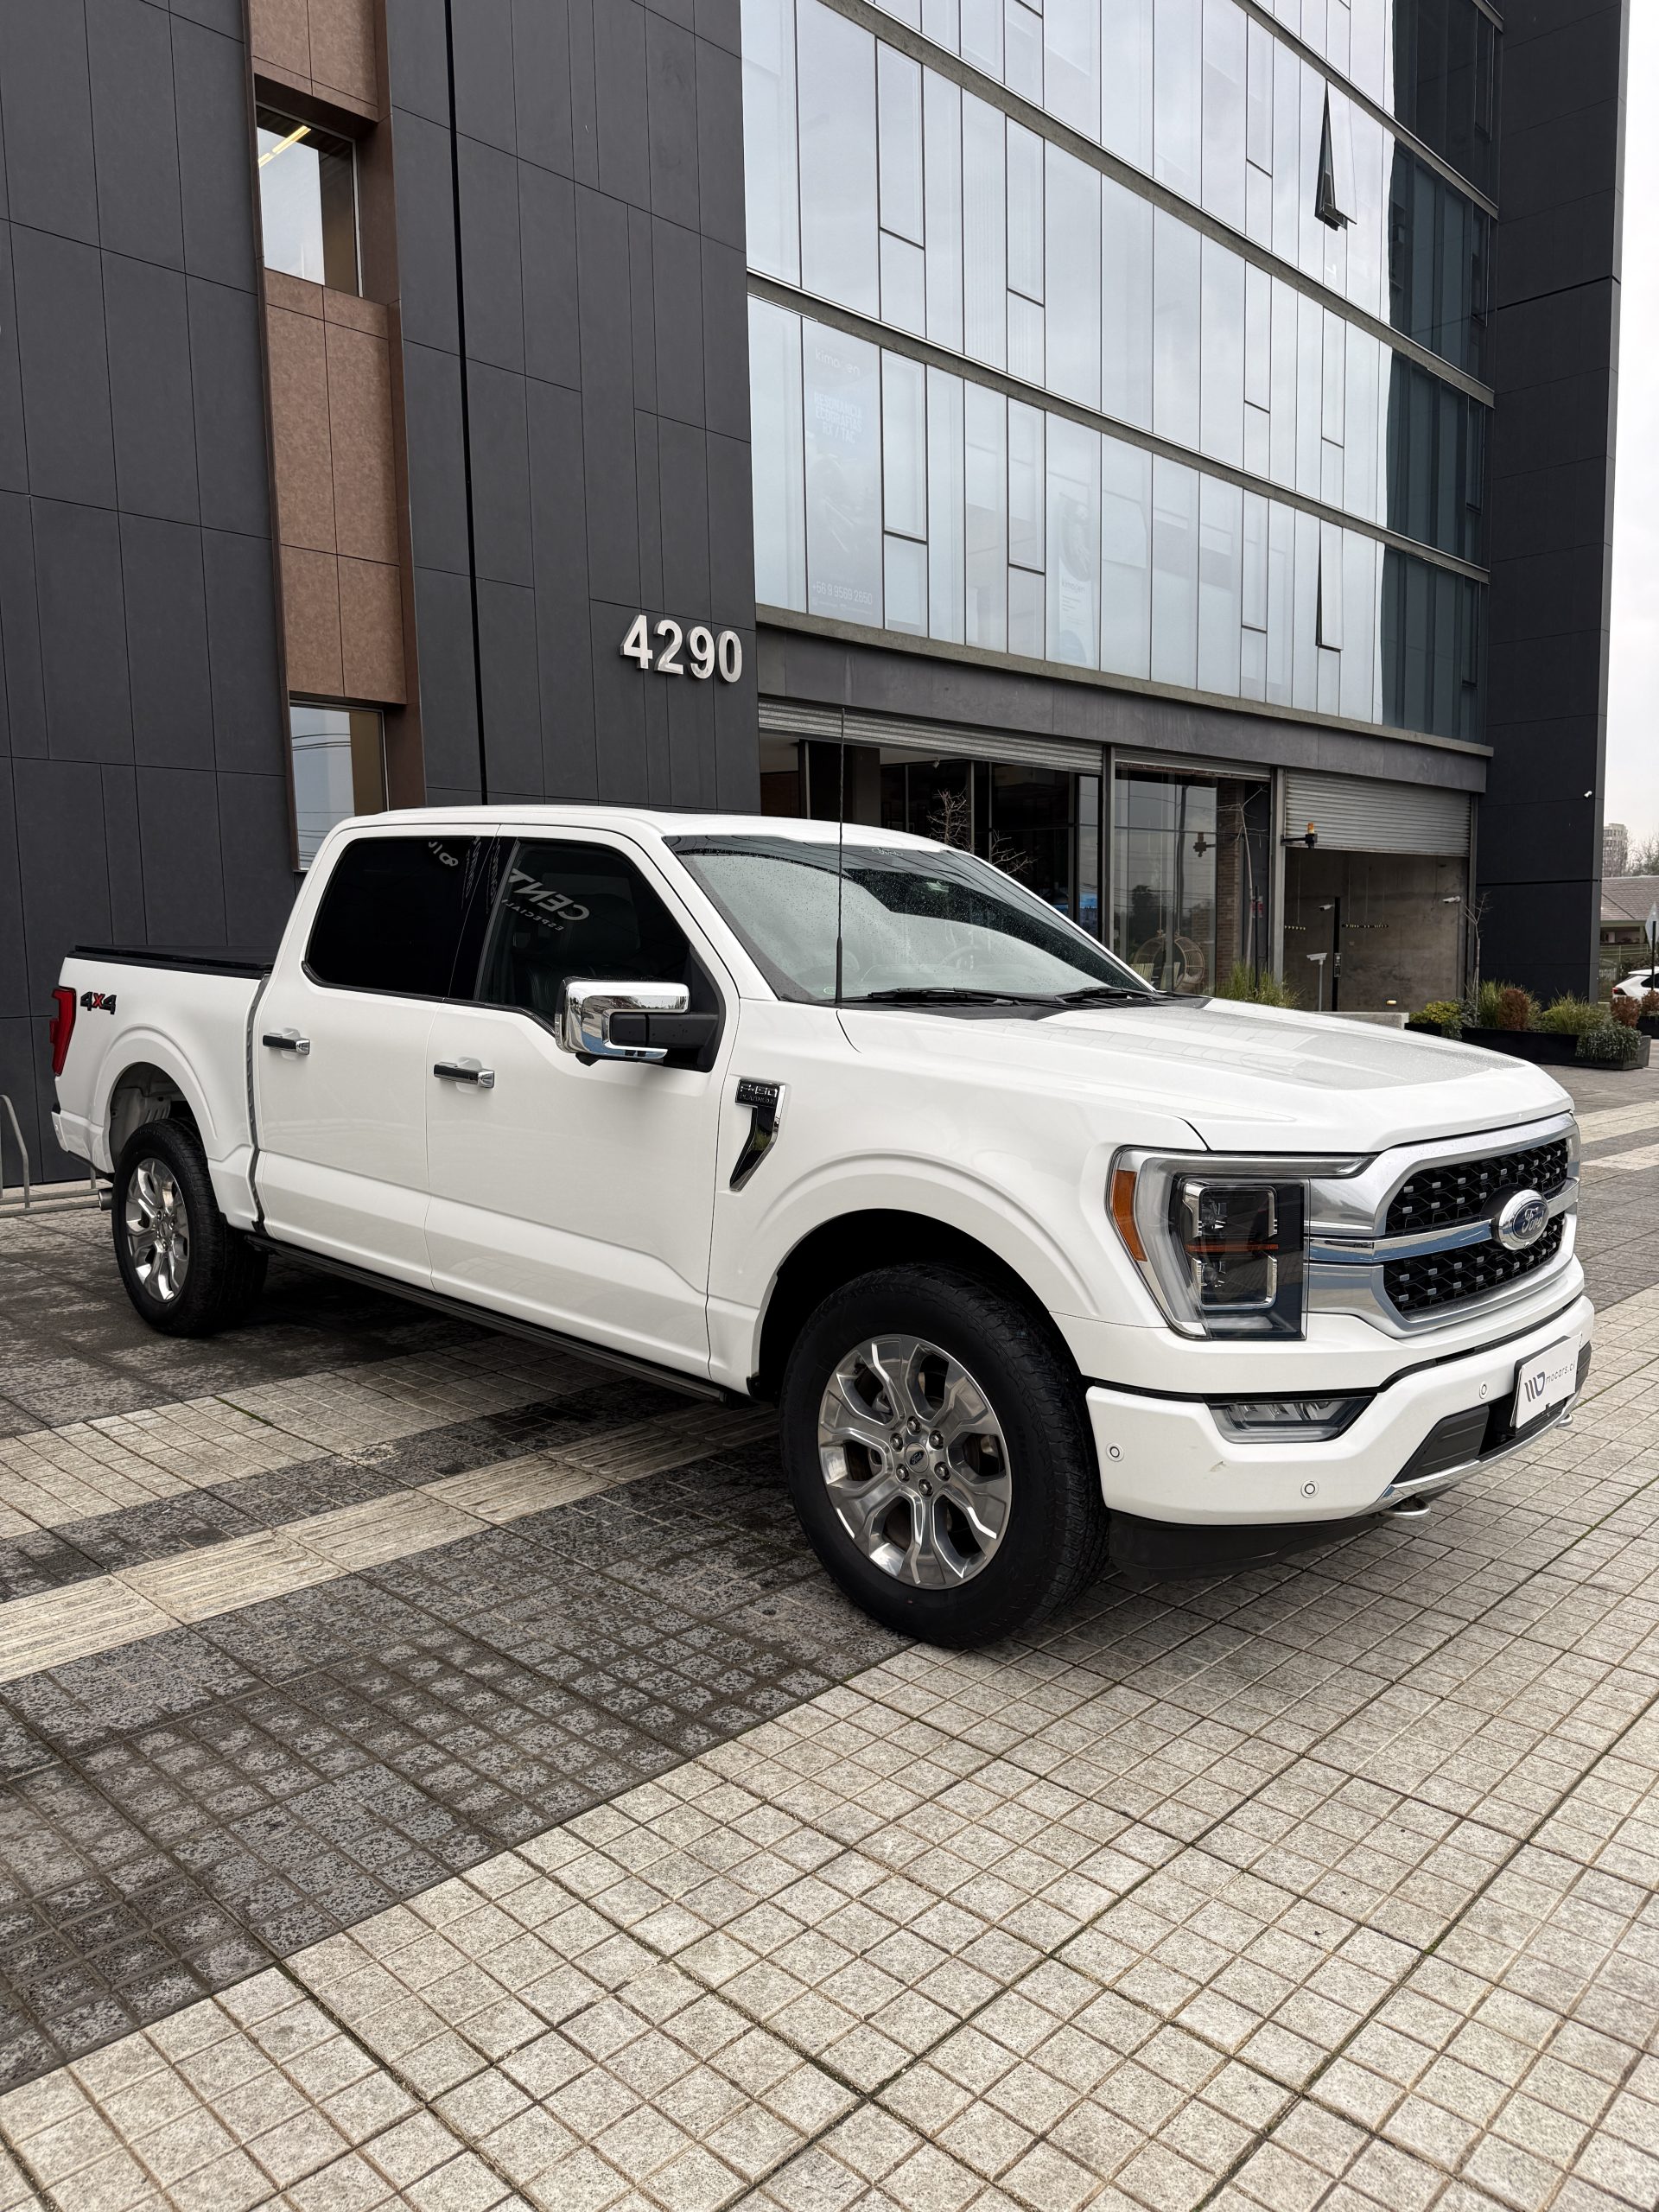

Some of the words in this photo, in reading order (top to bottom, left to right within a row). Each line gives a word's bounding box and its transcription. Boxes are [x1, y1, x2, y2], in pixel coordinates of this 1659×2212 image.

[815, 346, 861, 378] kimoen
[620, 614, 743, 683] 4290
[1522, 1206, 1545, 1234] Ford
